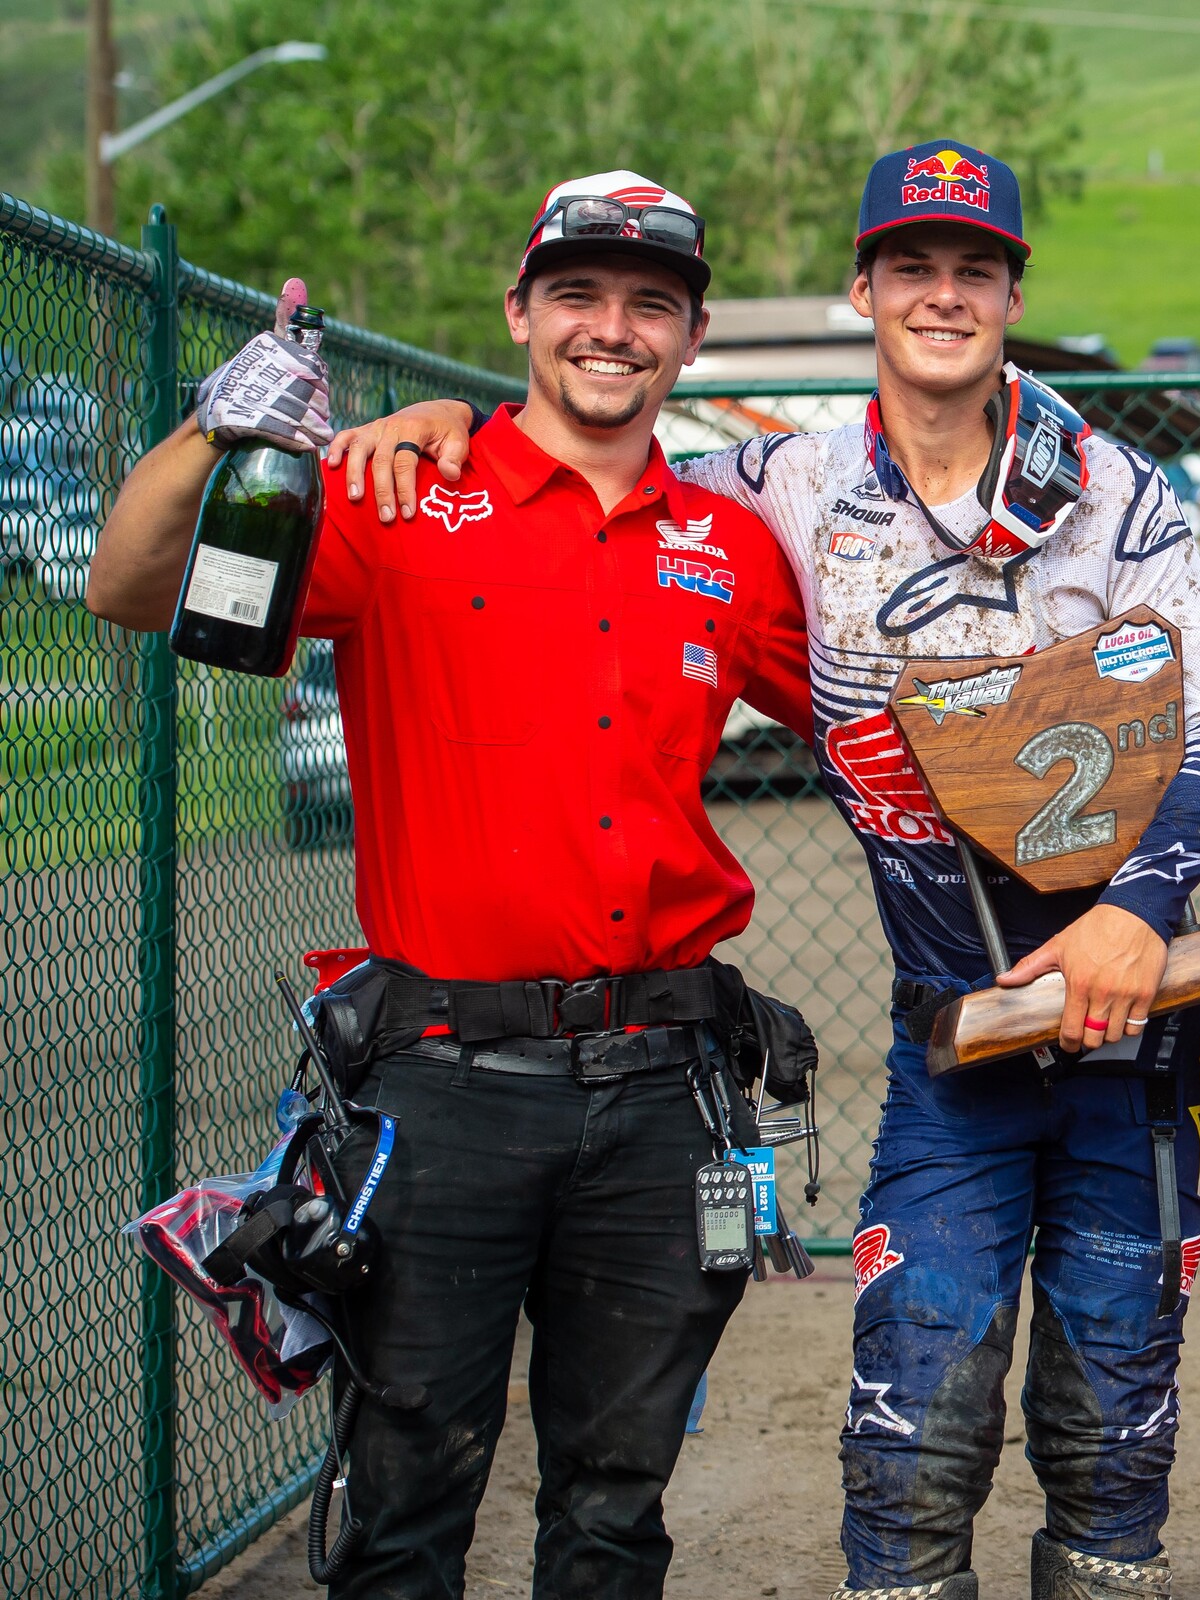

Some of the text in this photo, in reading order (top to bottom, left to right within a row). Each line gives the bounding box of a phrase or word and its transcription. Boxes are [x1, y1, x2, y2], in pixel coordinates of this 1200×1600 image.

[902, 181, 990, 212] Red Bull
[1030, 431, 1056, 479] 100%
[831, 498, 897, 526] SHOWA
[658, 540, 729, 561] HONDA
[832, 535, 875, 560] 100%
[657, 555, 735, 604] HRC
[1105, 629, 1153, 649] LUCAS OIL
[1099, 643, 1168, 667] MOTOCROSS
[927, 666, 1021, 700] Thunder
[944, 683, 1013, 712] Valley
[850, 802, 953, 845] HON
[937, 874, 1010, 885] DUOP
[747, 1162, 769, 1174] EW
[347, 1152, 388, 1231] CHRISTIEN
[760, 1184, 769, 1212] 2021
